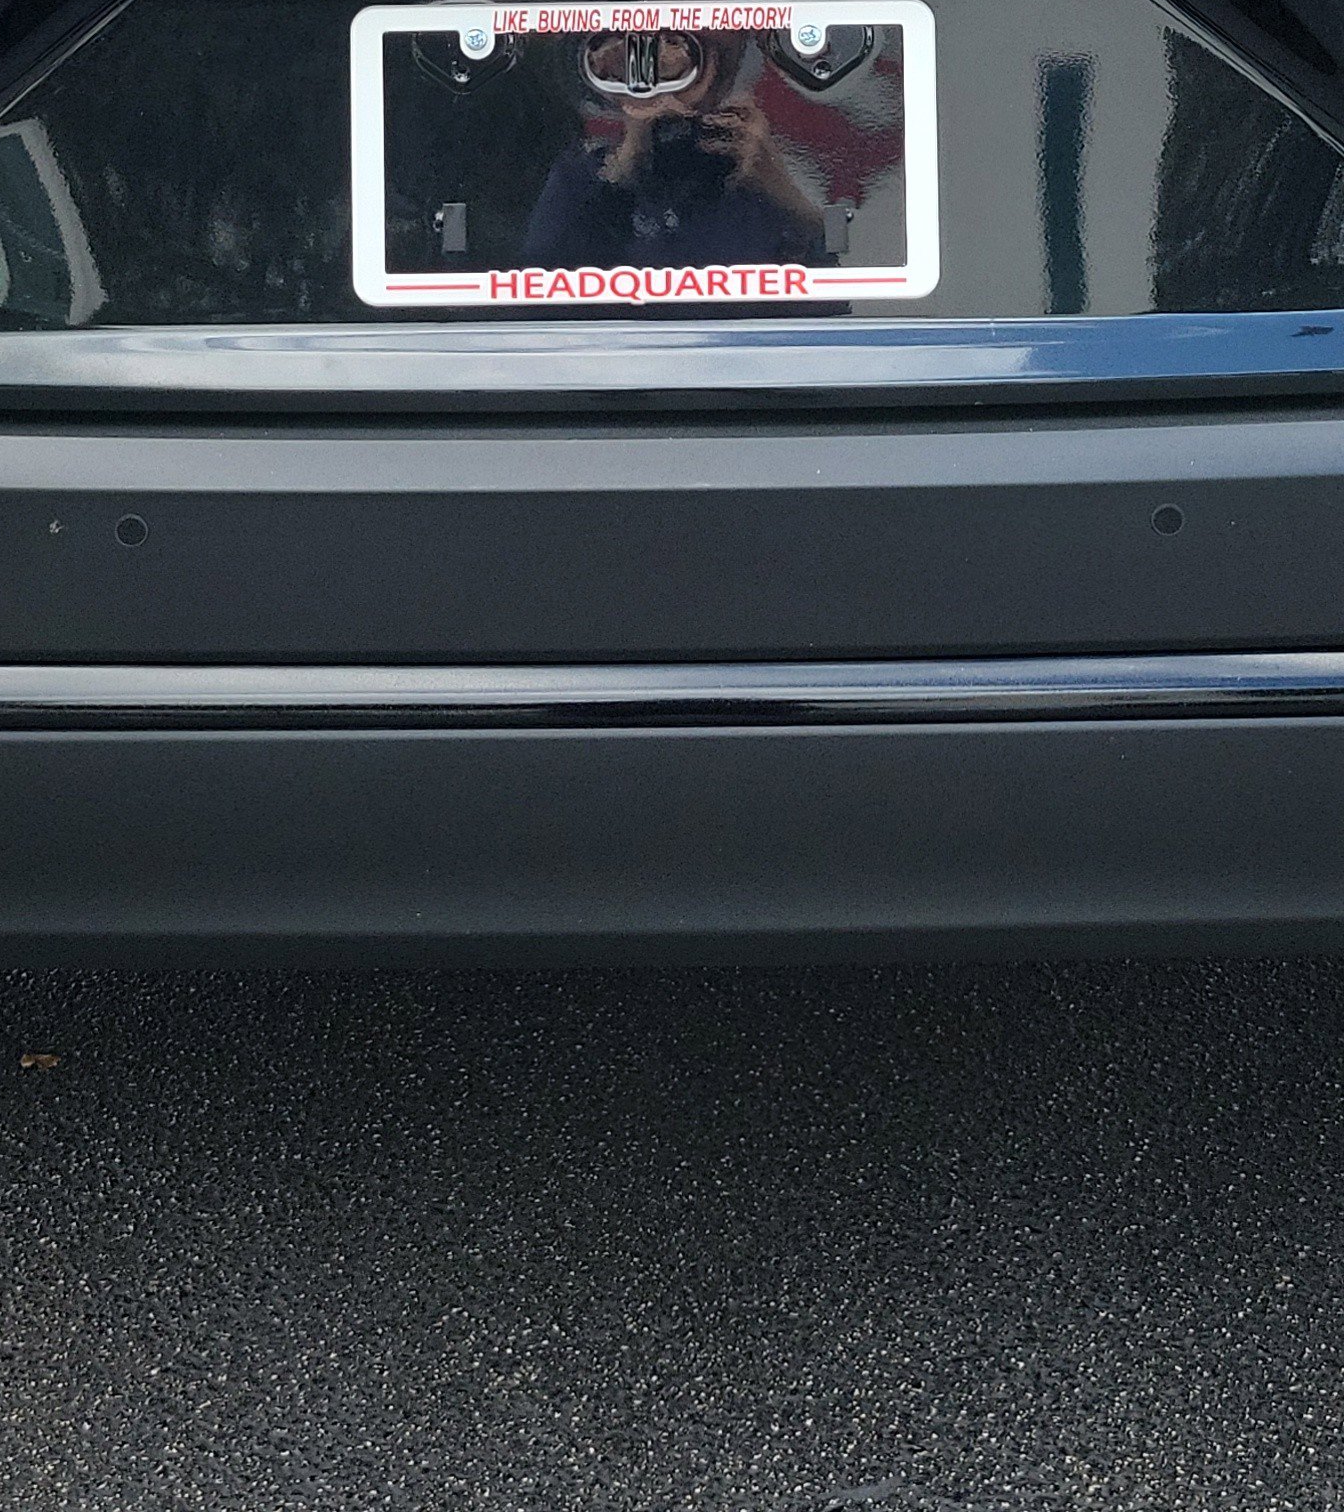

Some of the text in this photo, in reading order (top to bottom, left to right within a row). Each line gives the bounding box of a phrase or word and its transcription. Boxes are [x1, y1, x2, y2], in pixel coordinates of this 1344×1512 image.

[492, 6, 792, 32] LIKE BUYING FROM THE FACTORY!
[488, 268, 809, 302] HEADQUARTER
